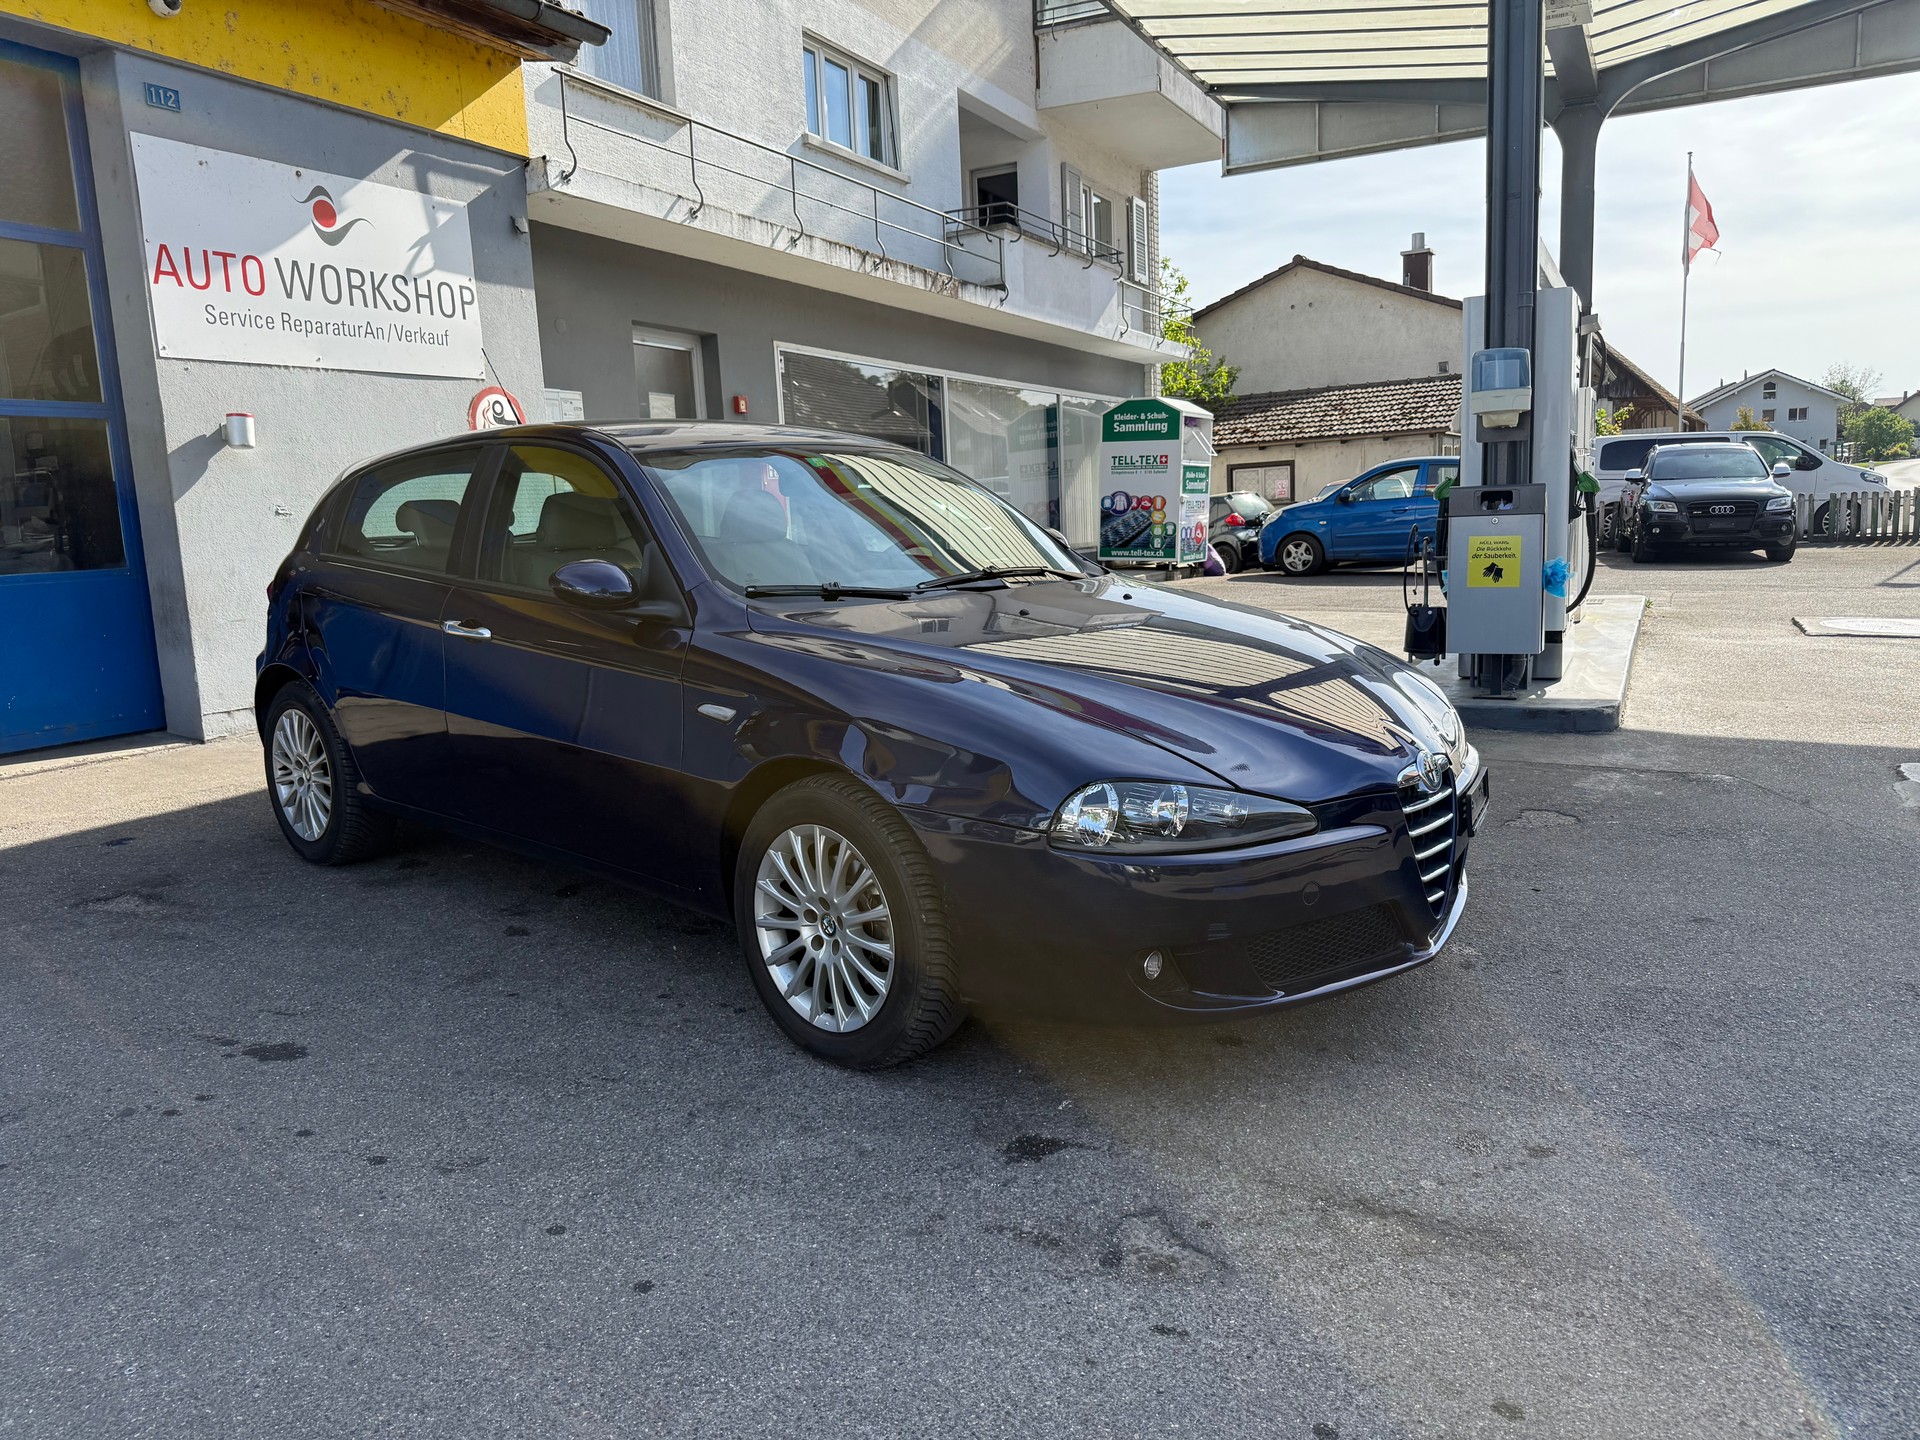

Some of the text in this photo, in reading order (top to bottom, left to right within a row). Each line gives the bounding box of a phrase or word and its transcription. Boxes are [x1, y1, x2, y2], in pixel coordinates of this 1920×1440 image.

[150, 87, 176, 108] 112
[153, 243, 476, 321] AUTO WORKSHOP
[204, 303, 450, 347] Service ReparaturAn/Verkauf
[1113, 411, 1169, 421] Kleider- & Schuh-
[1113, 420, 1168, 433] Sammlung
[1111, 455, 1159, 465] TELL-TEX
[1110, 549, 1164, 557] www.tell-tex.ch
